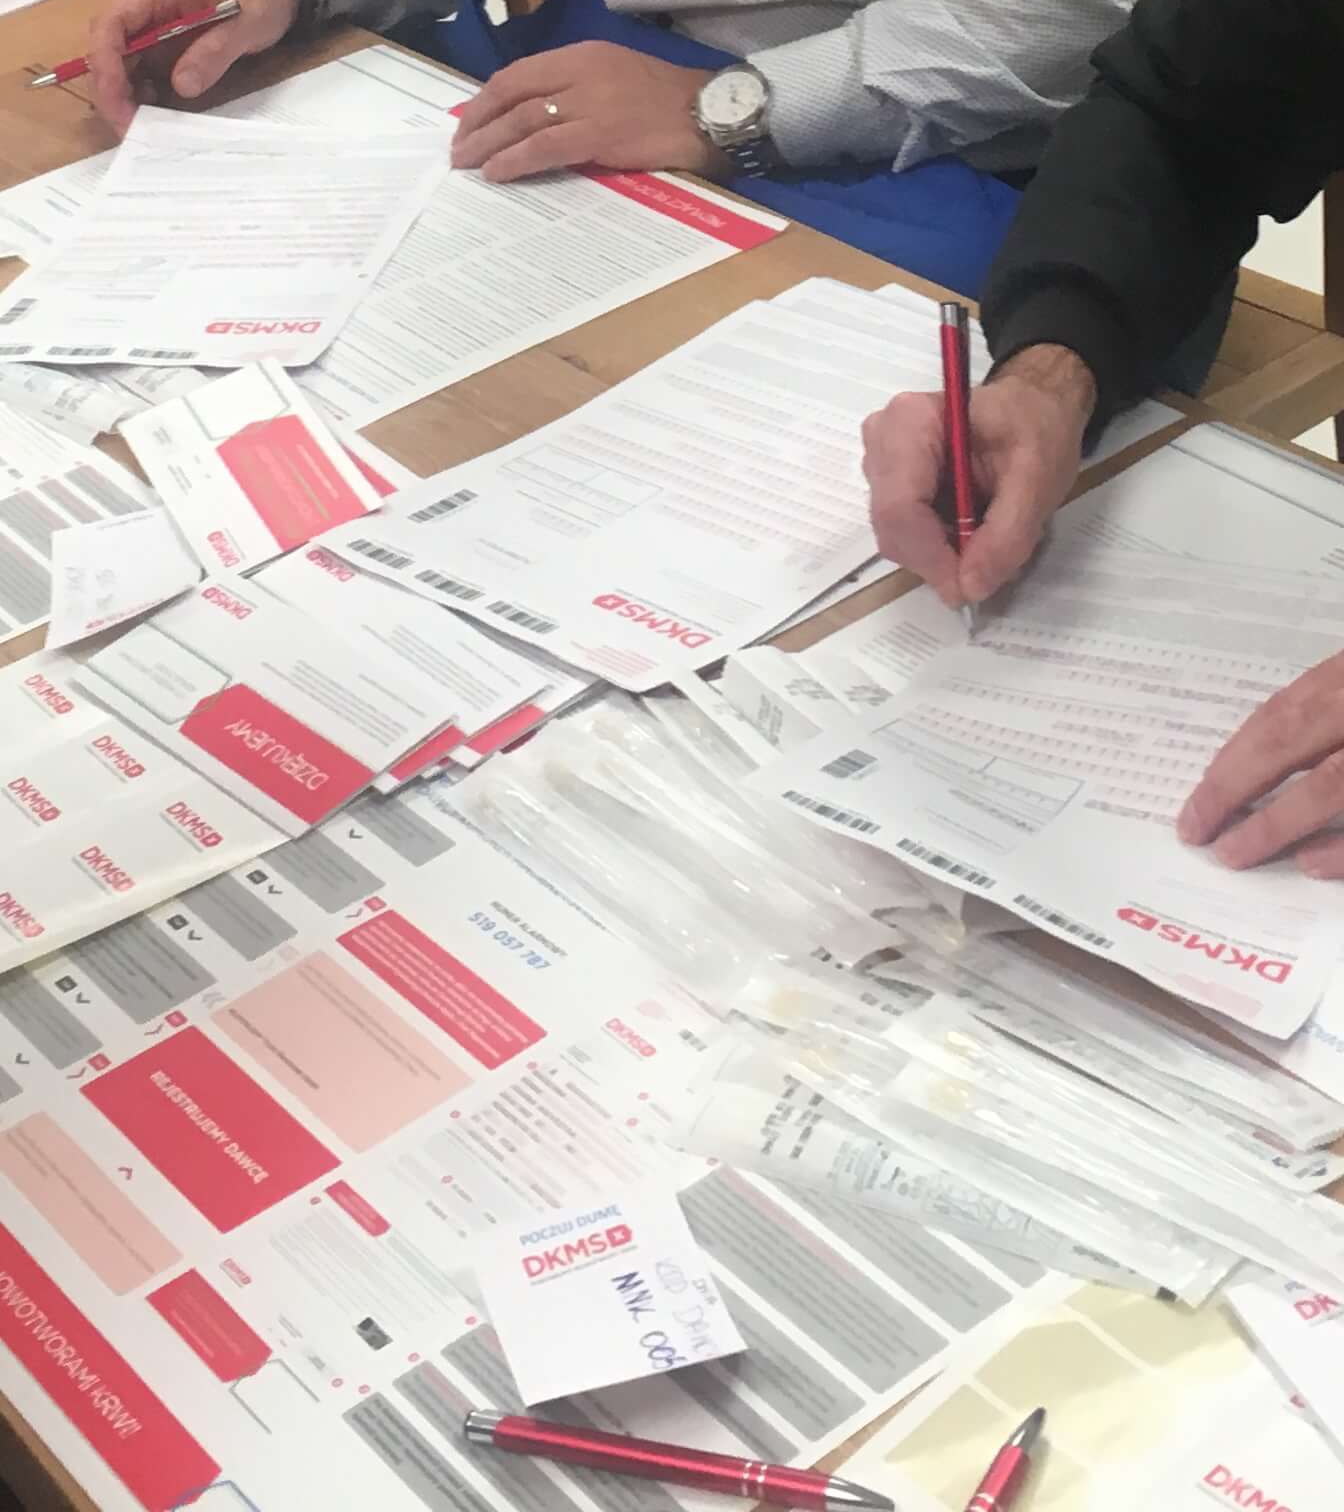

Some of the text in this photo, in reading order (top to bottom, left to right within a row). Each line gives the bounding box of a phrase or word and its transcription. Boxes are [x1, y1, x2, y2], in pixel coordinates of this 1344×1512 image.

[231, 321, 322, 335] DKMS
[205, 588, 254, 620] DKMS
[616, 604, 713, 649] DKMS
[223, 718, 331, 791] DZIĘKUJEMY
[468, 911, 497, 931] 519
[494, 930, 524, 950] 057
[1158, 923, 1293, 984] DKMS
[519, 1204, 622, 1246] POCZUJ DUMĘ
[521, 1232, 608, 1278] DKMS
